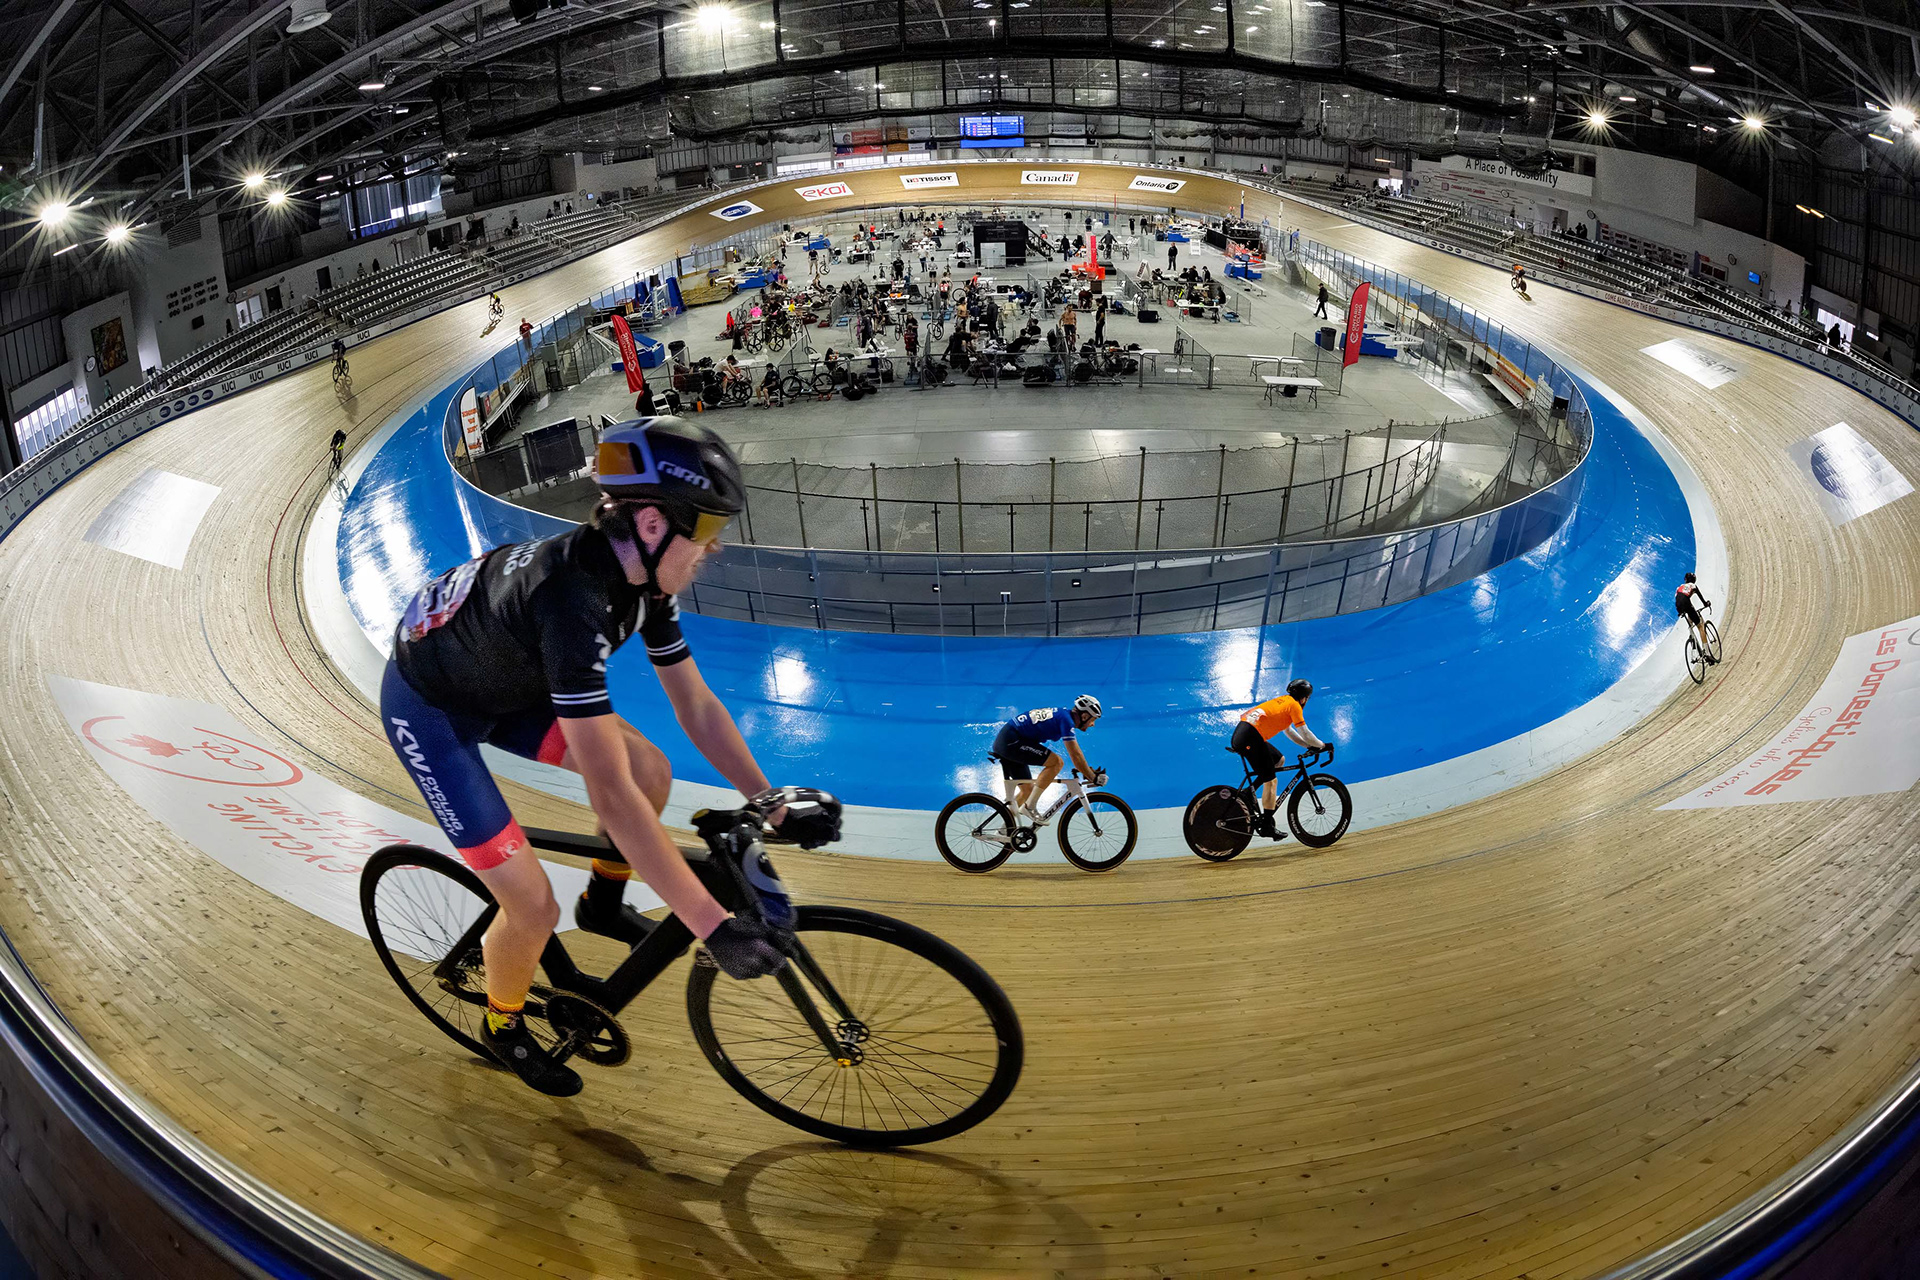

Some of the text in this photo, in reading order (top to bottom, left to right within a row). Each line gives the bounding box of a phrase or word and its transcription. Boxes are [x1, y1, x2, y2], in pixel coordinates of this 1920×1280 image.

[1026, 173, 1074, 183] Canada
[1465, 158, 1472, 169] A
[1474, 160, 1496, 173] Place
[1498, 165, 1508, 175] of
[1135, 180, 1165, 189] Ontario
[1604, 292, 1617, 302] COME
[1617, 296, 1631, 306] ALONG
[1631, 300, 1640, 309] FOR
[1640, 303, 1648, 312] THE
[1351, 303, 1359, 332] ONTARIO
[1355, 304, 1363, 332] CYCLING
[223, 380, 237, 393] UCI
[657, 460, 711, 490] GIRO
[1744, 627, 1909, 796] Les Domestiques
[391, 717, 432, 773] KW
[1696, 706, 1833, 798] Cyclists who serve
[416, 773, 459, 837] ACADEMY
[426, 776, 464, 831] CYCLING
[1275, 777, 1299, 807] DOLAN
[207, 803, 363, 873] CYCLING
